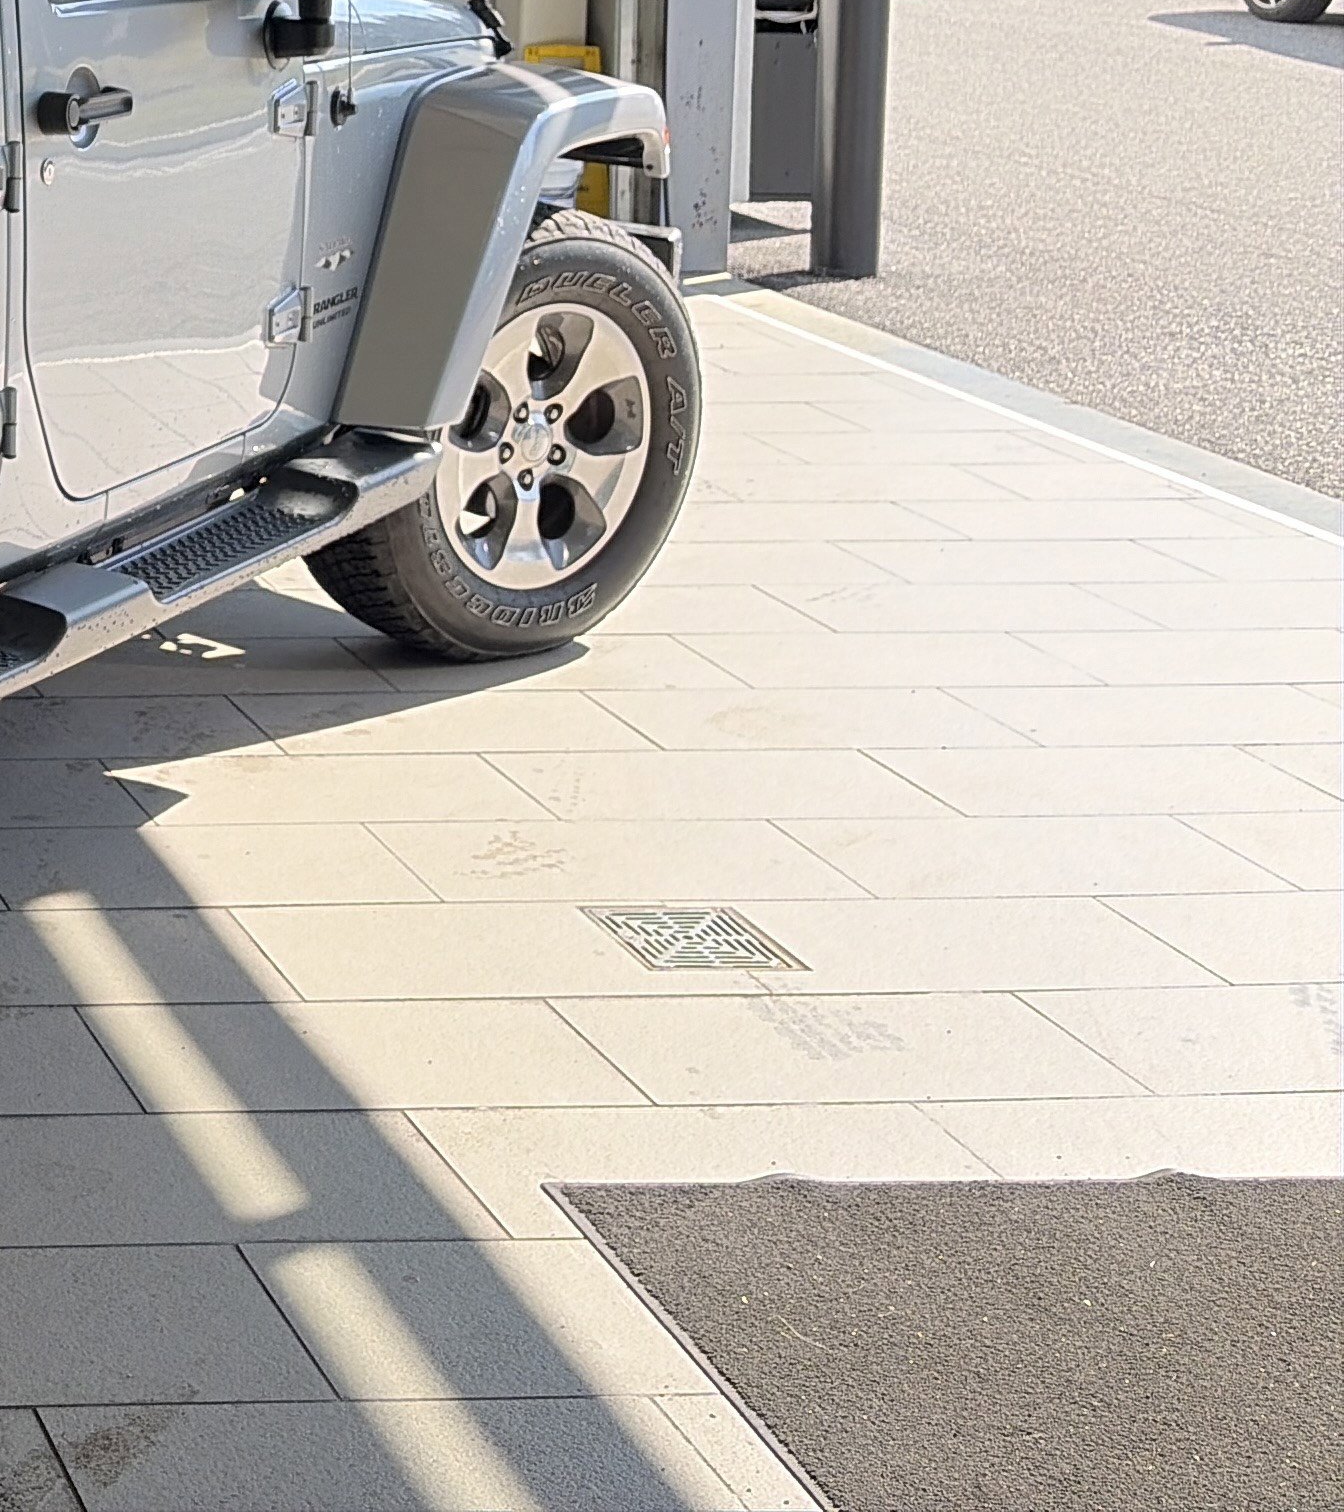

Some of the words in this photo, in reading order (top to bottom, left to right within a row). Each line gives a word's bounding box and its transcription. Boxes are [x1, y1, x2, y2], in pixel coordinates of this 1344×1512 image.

[313, 287, 359, 315] RANGLER
[516, 271, 677, 360] DUELER
[666, 376, 687, 476] A/T
[418, 491, 598, 627] BRIDGESTO
